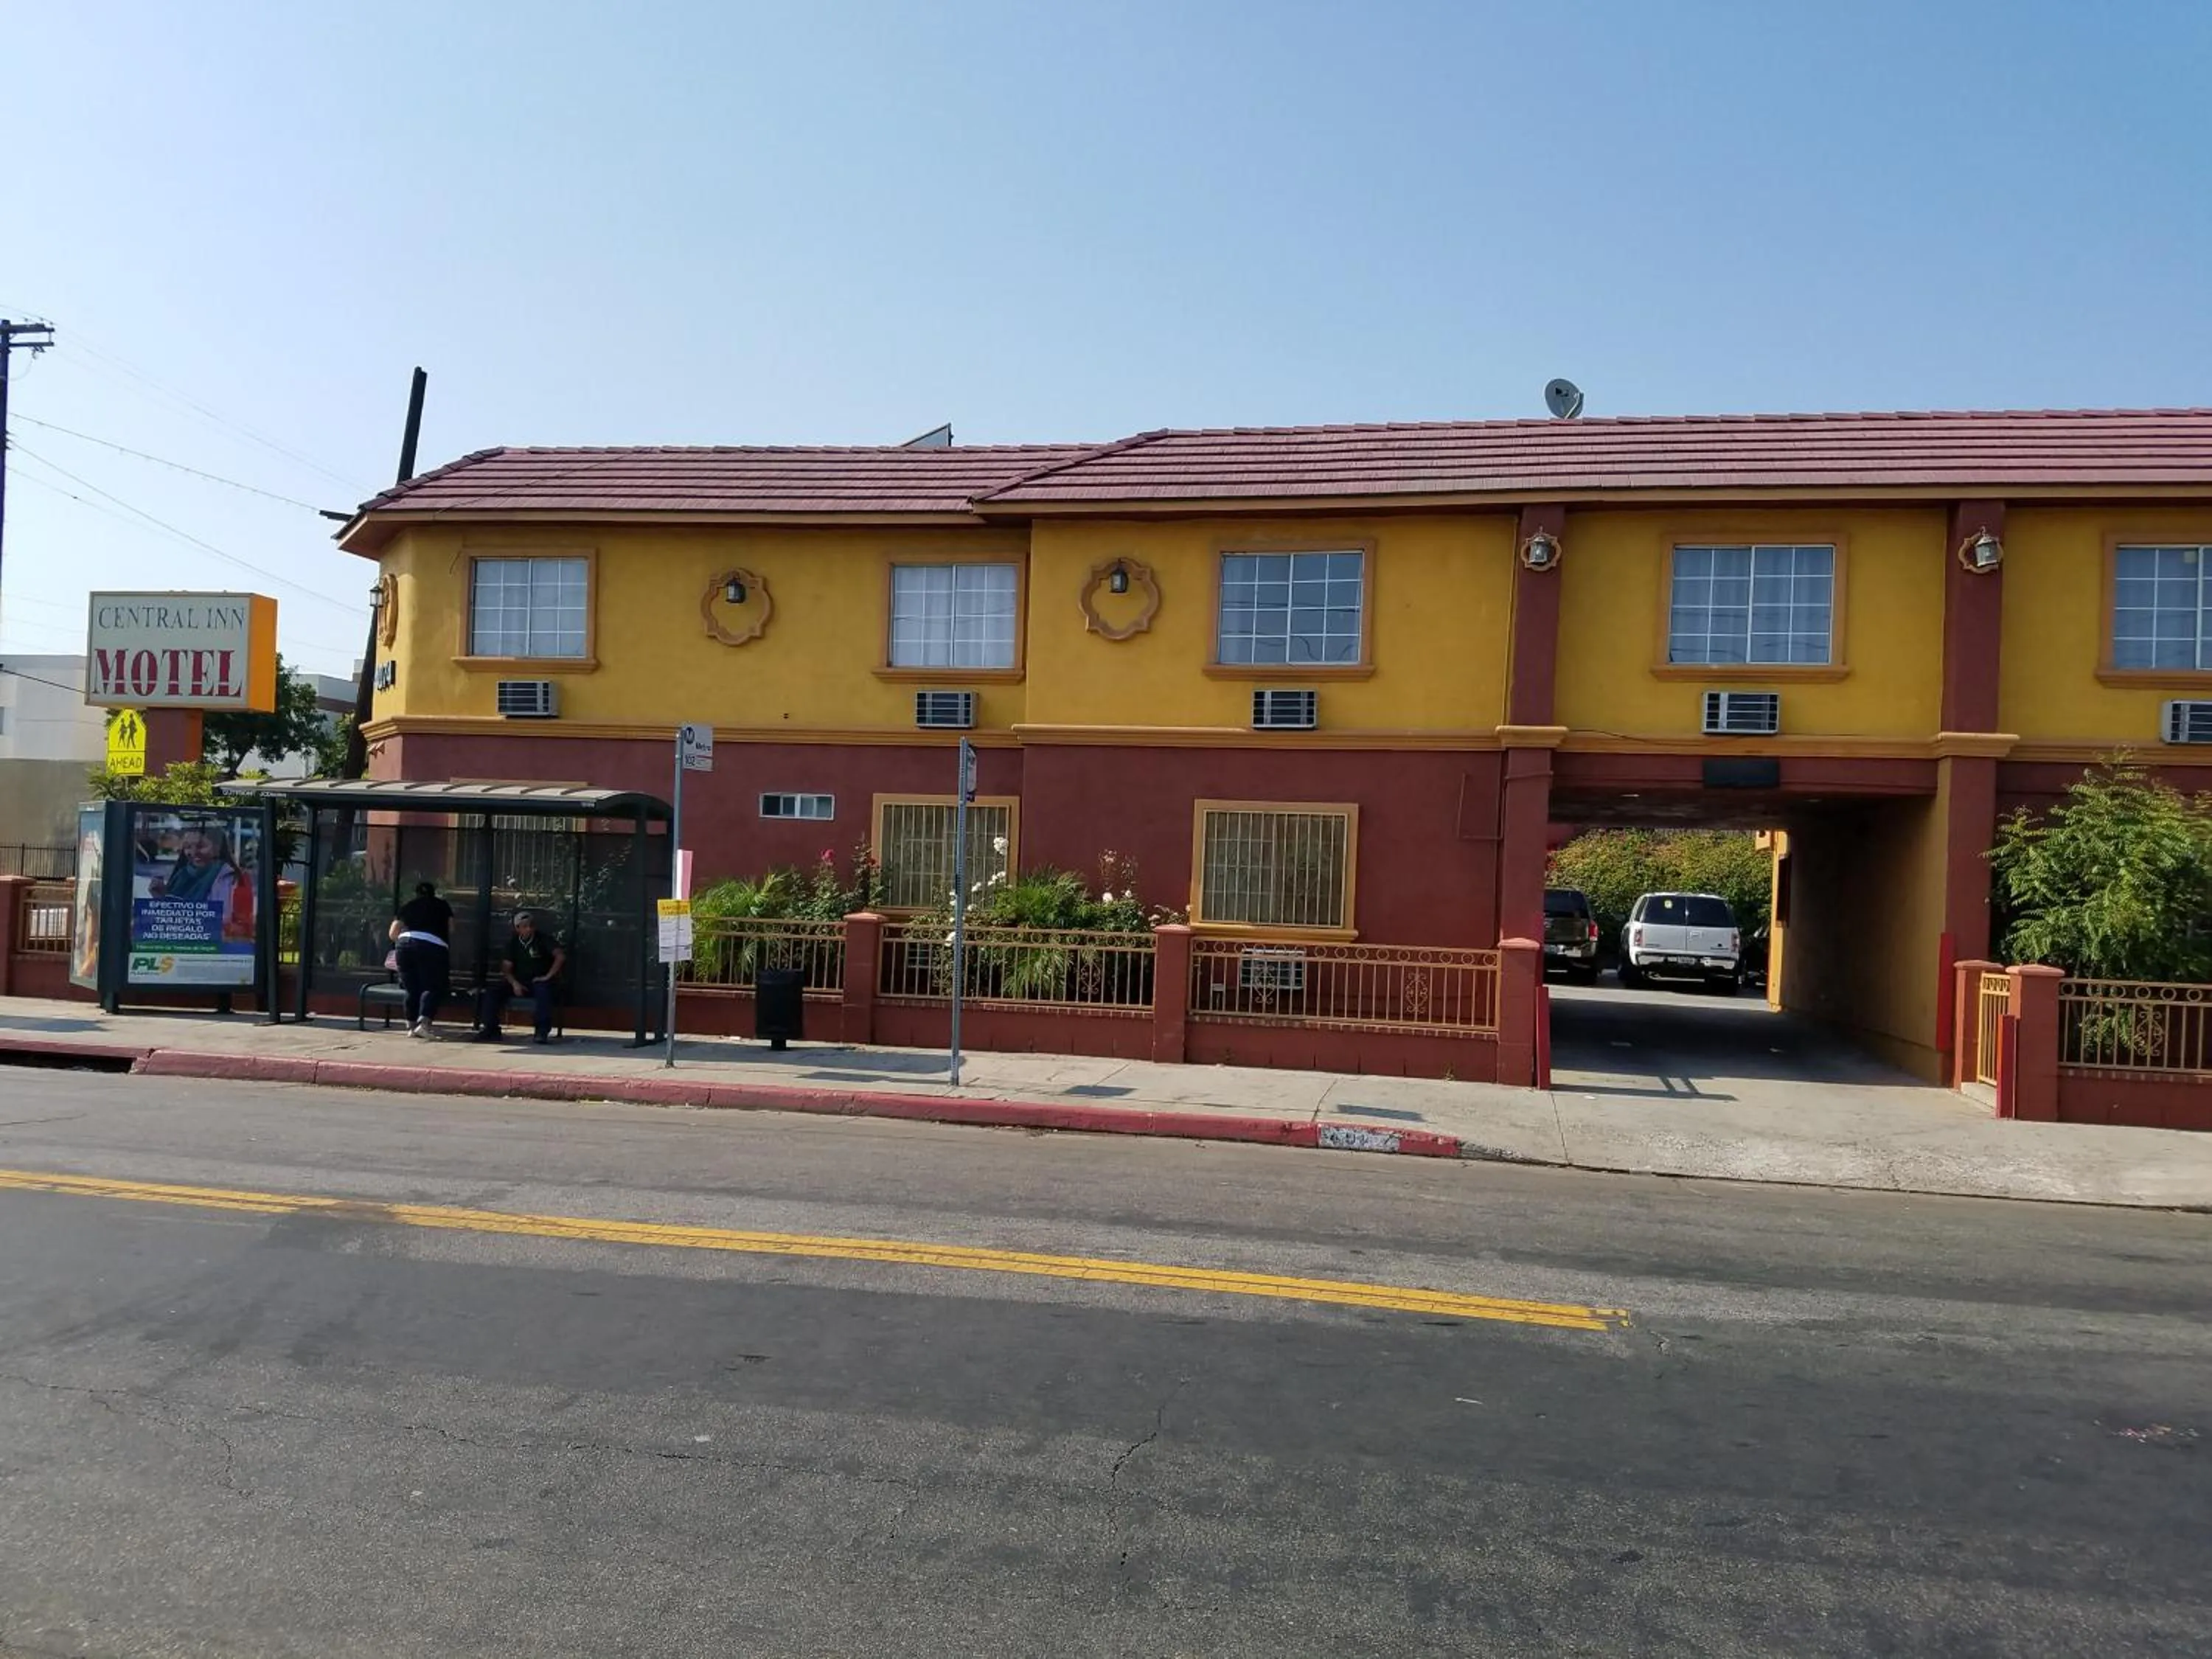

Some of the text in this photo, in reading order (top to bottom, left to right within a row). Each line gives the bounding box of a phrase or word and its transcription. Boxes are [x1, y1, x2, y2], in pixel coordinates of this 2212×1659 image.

[98, 606, 246, 630] CENTRAL INN
[92, 647, 243, 698] MOTEL
[110, 756, 142, 769] AHEAD
[149, 901, 194, 909] EFECTIVO
[166, 925, 204, 933] REGALO
[132, 956, 174, 973] PLS
